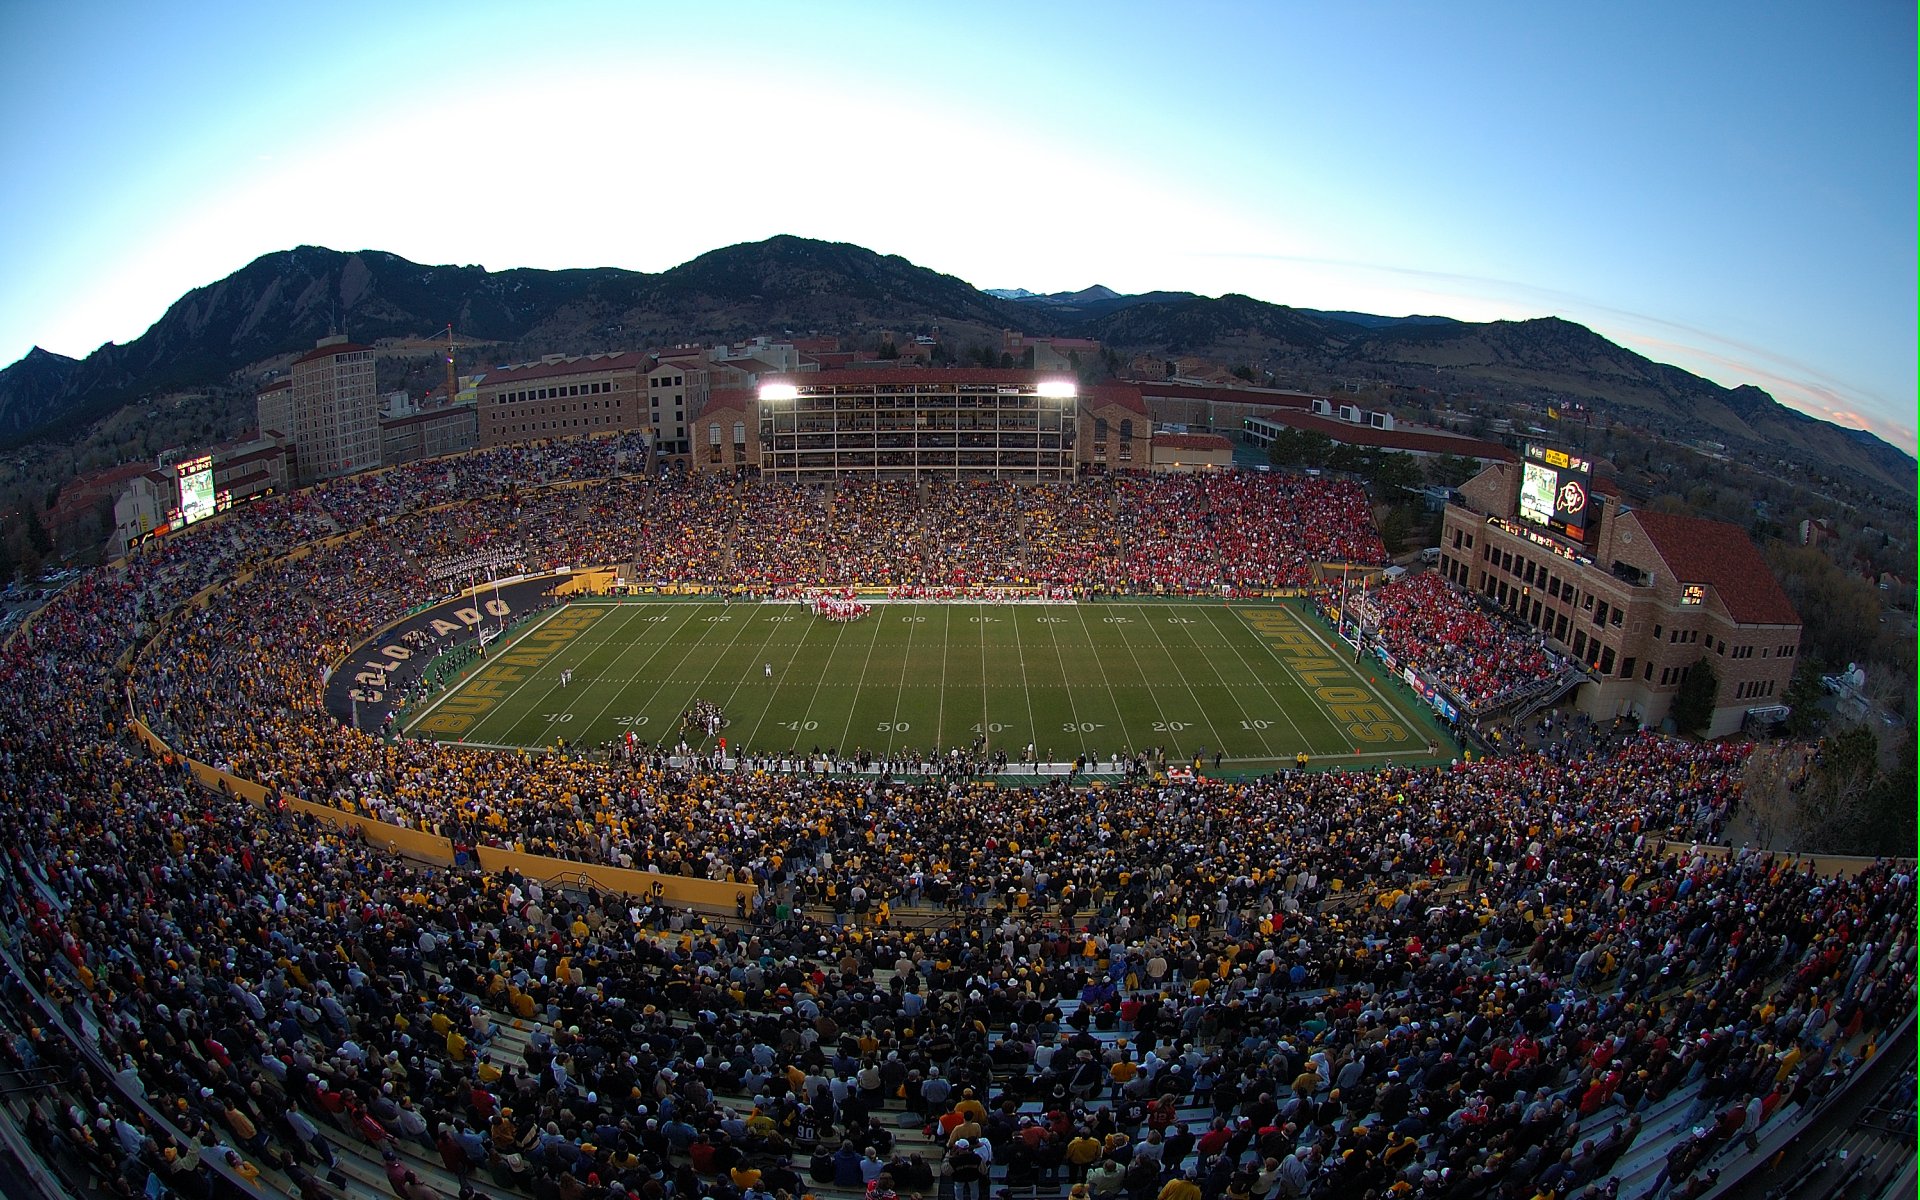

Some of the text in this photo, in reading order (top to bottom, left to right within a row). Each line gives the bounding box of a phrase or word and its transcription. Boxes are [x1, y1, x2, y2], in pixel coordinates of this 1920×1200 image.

[417, 608, 606, 734] BUFFALOES
[1238, 608, 1409, 743] BUFFALOES
[547, 713, 574, 723] 10
[617, 715, 650, 726] 20
[786, 721, 820, 732] 40
[876, 722, 911, 733] 50
[969, 722, 1004, 734] 40
[1062, 722, 1096, 733] 30
[1151, 721, 1185, 733] 20
[1239, 719, 1269, 731] 10
[797, 1125, 814, 1139] 90
